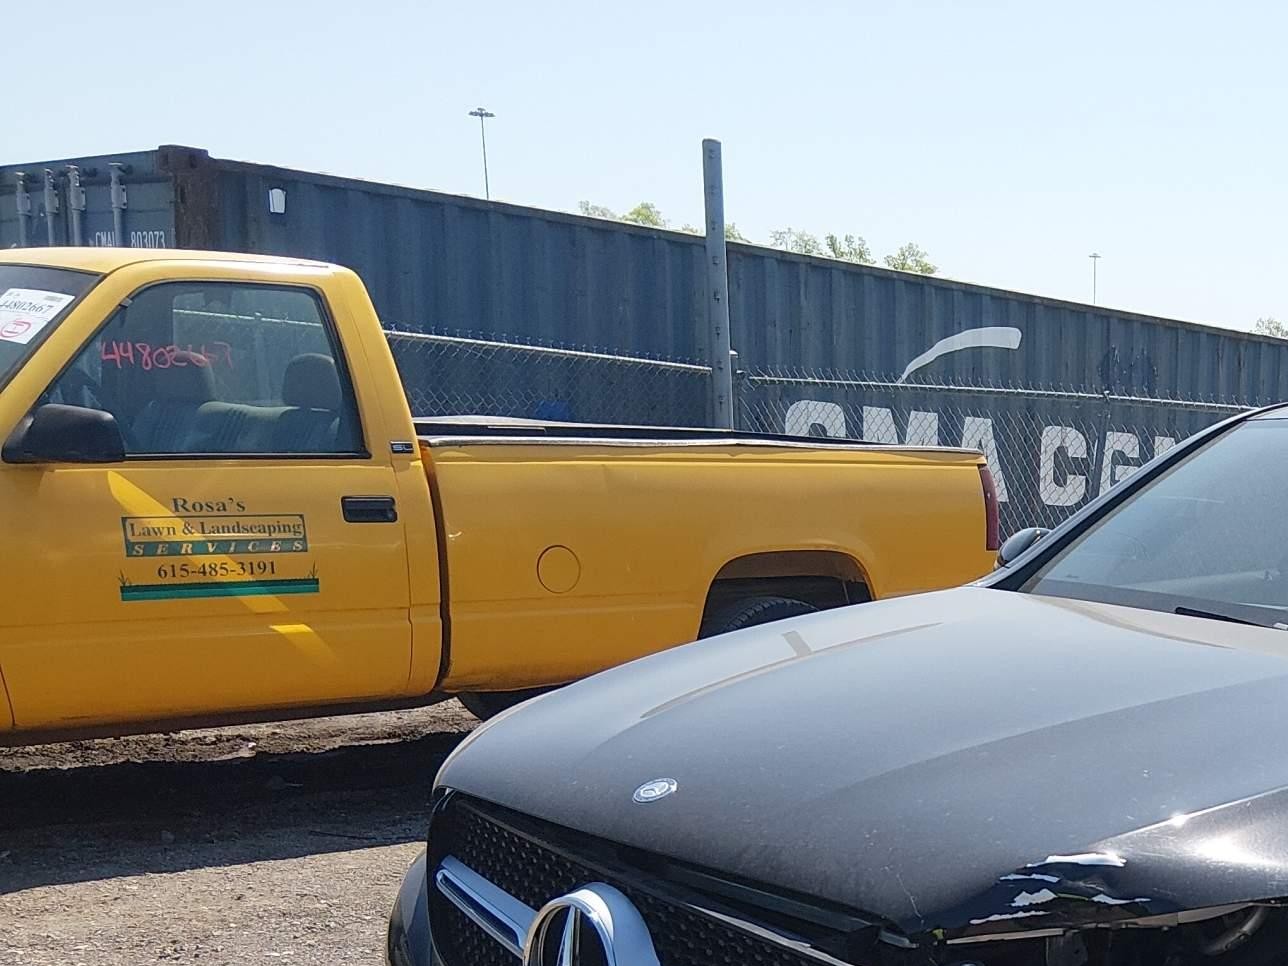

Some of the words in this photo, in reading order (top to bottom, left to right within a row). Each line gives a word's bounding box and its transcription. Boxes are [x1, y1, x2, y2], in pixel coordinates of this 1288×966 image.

[130, 231, 166, 248] 803073
[1039, 425, 1176, 506] CG
[173, 497, 246, 513] Rosa's
[129, 522, 177, 537] Lawn
[182, 519, 197, 535] &
[200, 520, 303, 537] Landscaping
[157, 561, 276, 579] 615-485-3191
